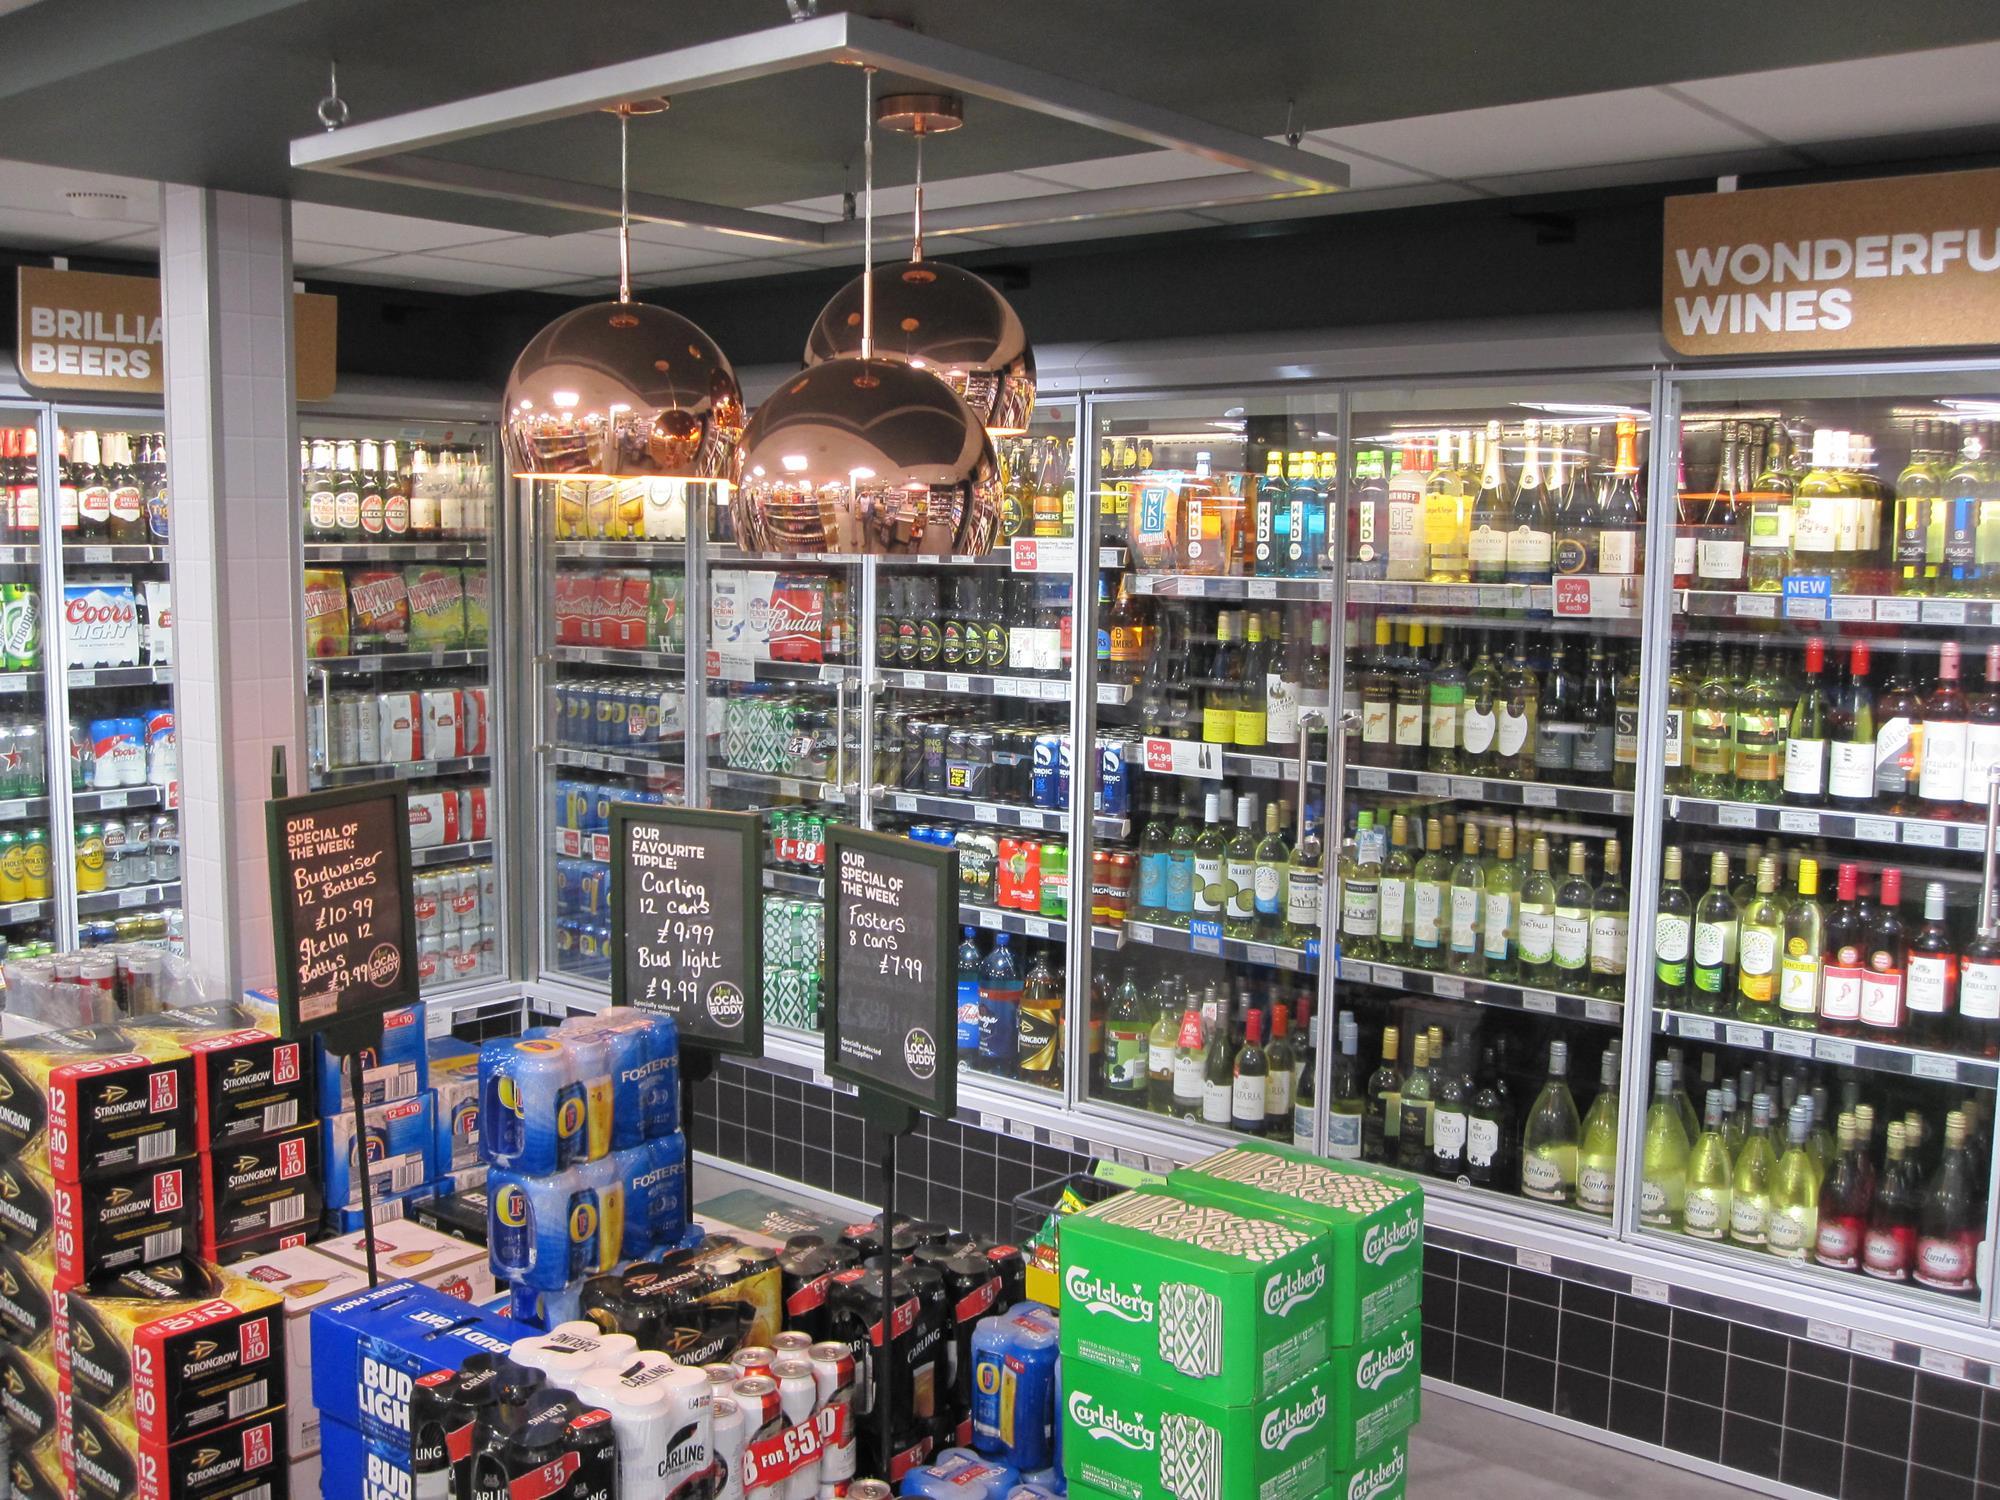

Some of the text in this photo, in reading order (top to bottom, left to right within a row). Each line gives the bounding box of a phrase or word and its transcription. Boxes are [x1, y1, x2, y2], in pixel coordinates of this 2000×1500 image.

[1676, 227, 2000, 288] WONDERFU
[1675, 288, 1853, 336] WINES
[31, 343, 151, 379] BEERS
[1147, 492, 1160, 528] WKD
[1016, 552, 1035, 560] £1.50
[1565, 583, 1581, 592] Only
[1788, 580, 1825, 594] NEW
[1559, 593, 1588, 604] £7.49
[65, 598, 135, 623] Coors
[10, 604, 36, 651] TUBORG
[70, 623, 131, 640] LIGHT
[1148, 752, 1171, 762] £4.99
[287, 818, 314, 833] OUR
[288, 823, 358, 847] SPECIAL OF
[633, 827, 659, 841] OUR
[113, 851, 119, 861] 4
[167, 845, 173, 855] 4
[288, 838, 355, 861] THE WEEK:
[633, 840, 704, 859] FAVOURITE
[841, 851, 865, 868] OUR
[294, 851, 382, 889] Budweiser
[633, 854, 677, 870] TIPPLE:
[299, 871, 376, 906] 12 Bottles
[642, 871, 705, 901] Carling
[841, 866, 903, 892] SPECIAL OF
[841, 880, 900, 907] THE WEEK:
[315, 898, 373, 931] £10.99
[640, 898, 657, 914] 12
[849, 904, 906, 933] Fosters
[657, 919, 714, 945] £9.99
[850, 930, 857, 946] 8
[1194, 923, 1218, 936] NEW
[300, 923, 373, 966] Stella 12
[300, 955, 346, 983] Bottles
[370, 951, 398, 971] LOCAL
[371, 960, 399, 981] BUDDY
[638, 947, 722, 978] Bud light
[879, 954, 922, 983] £7.99
[327, 964, 368, 992] £9.99
[646, 977, 698, 1004] £9.99
[709, 994, 743, 1005] LOCAL
[710, 1004, 743, 1016] BUDDY
[279, 1048, 290, 1061] 12
[906, 1043, 935, 1056] LOCAL
[907, 1053, 935, 1067] BUDDY
[277, 1064, 295, 1081] £10
[621, 1055, 678, 1083] FOSTER'S
[157, 1074, 168, 1087] 12
[223, 1070, 270, 1091] STRONGBOW
[50, 1087, 65, 1115] 12
[95, 1099, 147, 1120] STRONGBOW
[155, 1092, 172, 1109] £10
[50, 1113, 67, 1127] CANS
[387, 1109, 396, 1118] 12
[51, 1129, 67, 1155] £10
[285, 1143, 296, 1156] 12
[229, 1167, 277, 1188] STRONGBOW
[284, 1159, 301, 1177] £10
[161, 1174, 173, 1188] 12
[56, 1190, 71, 1217] 12
[100, 1199, 151, 1221] STRONGBOW
[159, 1191, 177, 1208] £10
[56, 1216, 72, 1230] CANS
[57, 1230, 73, 1255] £10
[1363, 1215, 1419, 1265] Carlsberg
[368, 1282, 414, 1299] FRIDGE
[1066, 1265, 1153, 1323] Carlsberg
[1264, 1263, 1326, 1316] Carlsberg
[331, 1297, 369, 1313] PACK
[897, 1304, 913, 1325] £5
[247, 1324, 260, 1338] 12
[246, 1342, 264, 1359] £10
[552, 1332, 600, 1352] CARLING
[907, 1328, 940, 1363] CARLING
[71, 1347, 114, 1387] STRONGBOW
[134, 1345, 152, 1374] 12
[184, 1351, 238, 1378] STRONGBOW
[1356, 1337, 1415, 1390] Carlsberg
[135, 1373, 154, 1388] CANS
[364, 1357, 412, 1397] BUD
[461, 1370, 497, 1390] CARLING
[621, 1364, 674, 1388] CARLING
[136, 1388, 155, 1415] £10
[527, 1403, 568, 1426] CARLING
[1069, 1391, 1155, 1451] Carlsberg
[1260, 1394, 1327, 1452] Carlsberg
[250, 1429, 263, 1442] 12
[249, 1447, 266, 1465] £10
[416, 1447, 442, 1460] LING
[658, 1444, 704, 1477] CARLING
[762, 1452, 784, 1469] FOR
[76, 1450, 120, 1492] STRONGBOW
[139, 1453, 156, 1480] 12
[187, 1457, 240, 1486] STRONGBOW
[368, 1453, 412, 1489] BUD
[544, 1465, 564, 1486] £5
[1348, 1450, 1404, 1500] Carlsberg
